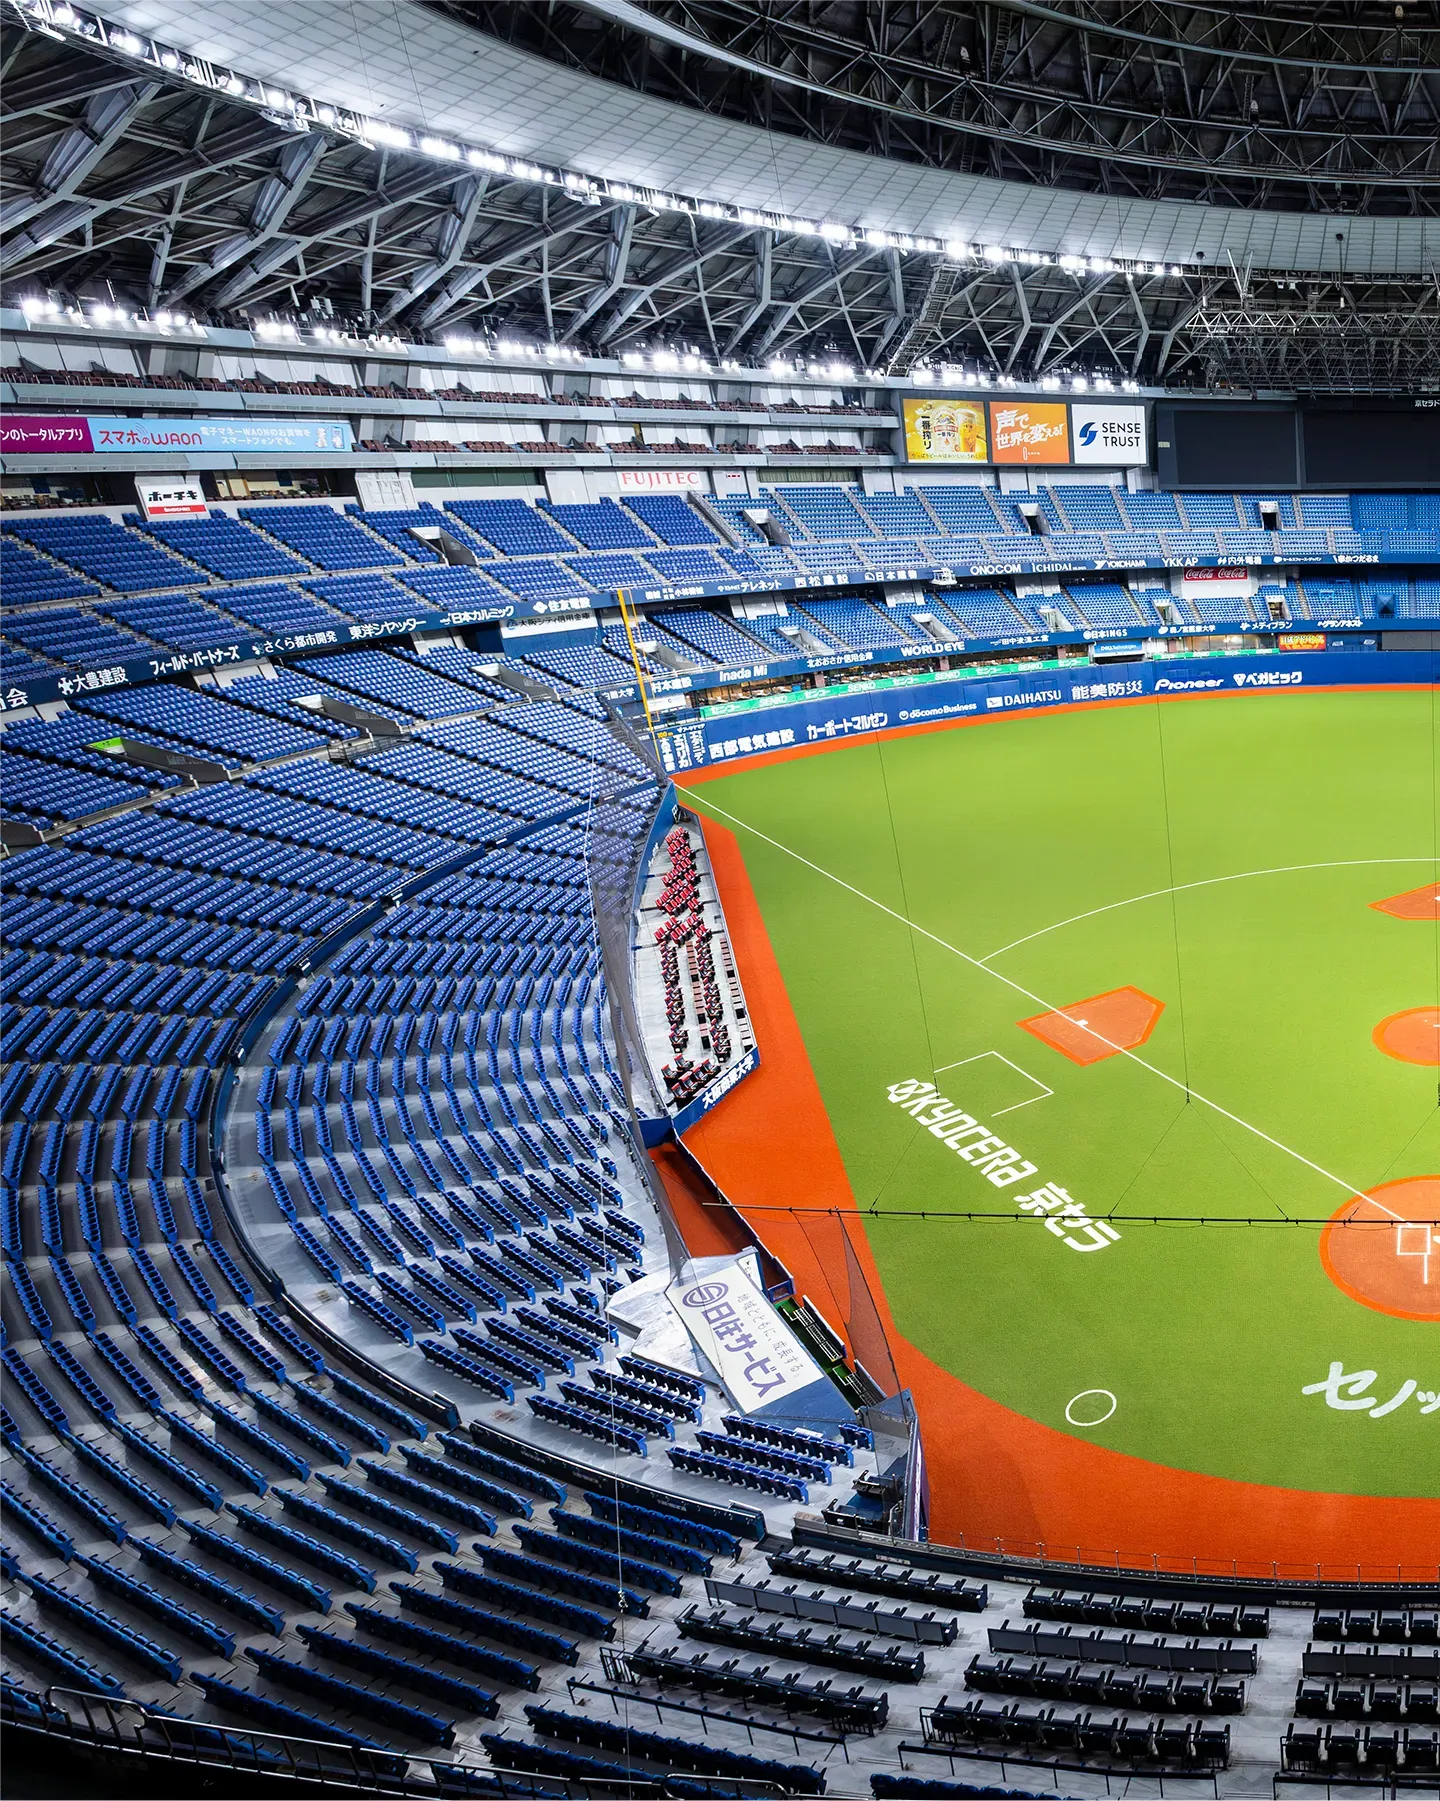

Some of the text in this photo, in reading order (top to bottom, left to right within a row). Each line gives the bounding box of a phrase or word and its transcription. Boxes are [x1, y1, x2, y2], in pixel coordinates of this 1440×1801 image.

[996, 410, 1029, 434] 声で
[1102, 422, 1141, 432] SENSE
[921, 416, 932, 450] 一番搾り
[1103, 436, 1140, 446] TRUST
[622, 472, 699, 488] FUJITEC
[148, 490, 198, 502] ホーチキ
[1032, 562, 1072, 572] ICHIDAI
[1106, 559, 1146, 568] YOKOHAMA
[1162, 558, 1198, 566] YKK AP
[970, 564, 1022, 576] ONOCOM
[1185, 568, 1214, 580] Coca-Cola
[1218, 568, 1248, 578] Coca-Cola
[740, 579, 782, 592] テレネット
[794, 574, 848, 588] 西松建設
[548, 598, 592, 612] 住友電設
[450, 606, 514, 625] 日本カルミック
[520, 612, 591, 628] 大阪シティ信用金庫
[264, 630, 338, 653] さくら都市開発
[150, 645, 240, 676] フィールド・パートナーズ
[806, 652, 873, 668] 北おおさか信用金庫
[1018, 662, 1042, 672] SENKO
[74, 666, 128, 692] 大豊建設
[720, 665, 768, 682] Inada Mi
[934, 670, 960, 680] SENKO
[847, 682, 876, 692] SENKO
[1072, 680, 1142, 700] 能美防災
[1154, 678, 1224, 690] Pioneer
[760, 694, 788, 706] SENKO
[1004, 690, 1062, 706] DAIHATSU
[944, 702, 977, 714] Business
[807, 712, 888, 740] カーポートマルゼン
[708, 728, 796, 760] 西部電気建設
[900, 1092, 1038, 1188] KYOCERA
[1013, 1182, 1122, 1252] 京セラ
[737, 1293, 804, 1379] 地域とともに、成長する。
[702, 1301, 786, 1398] 日住サービス
